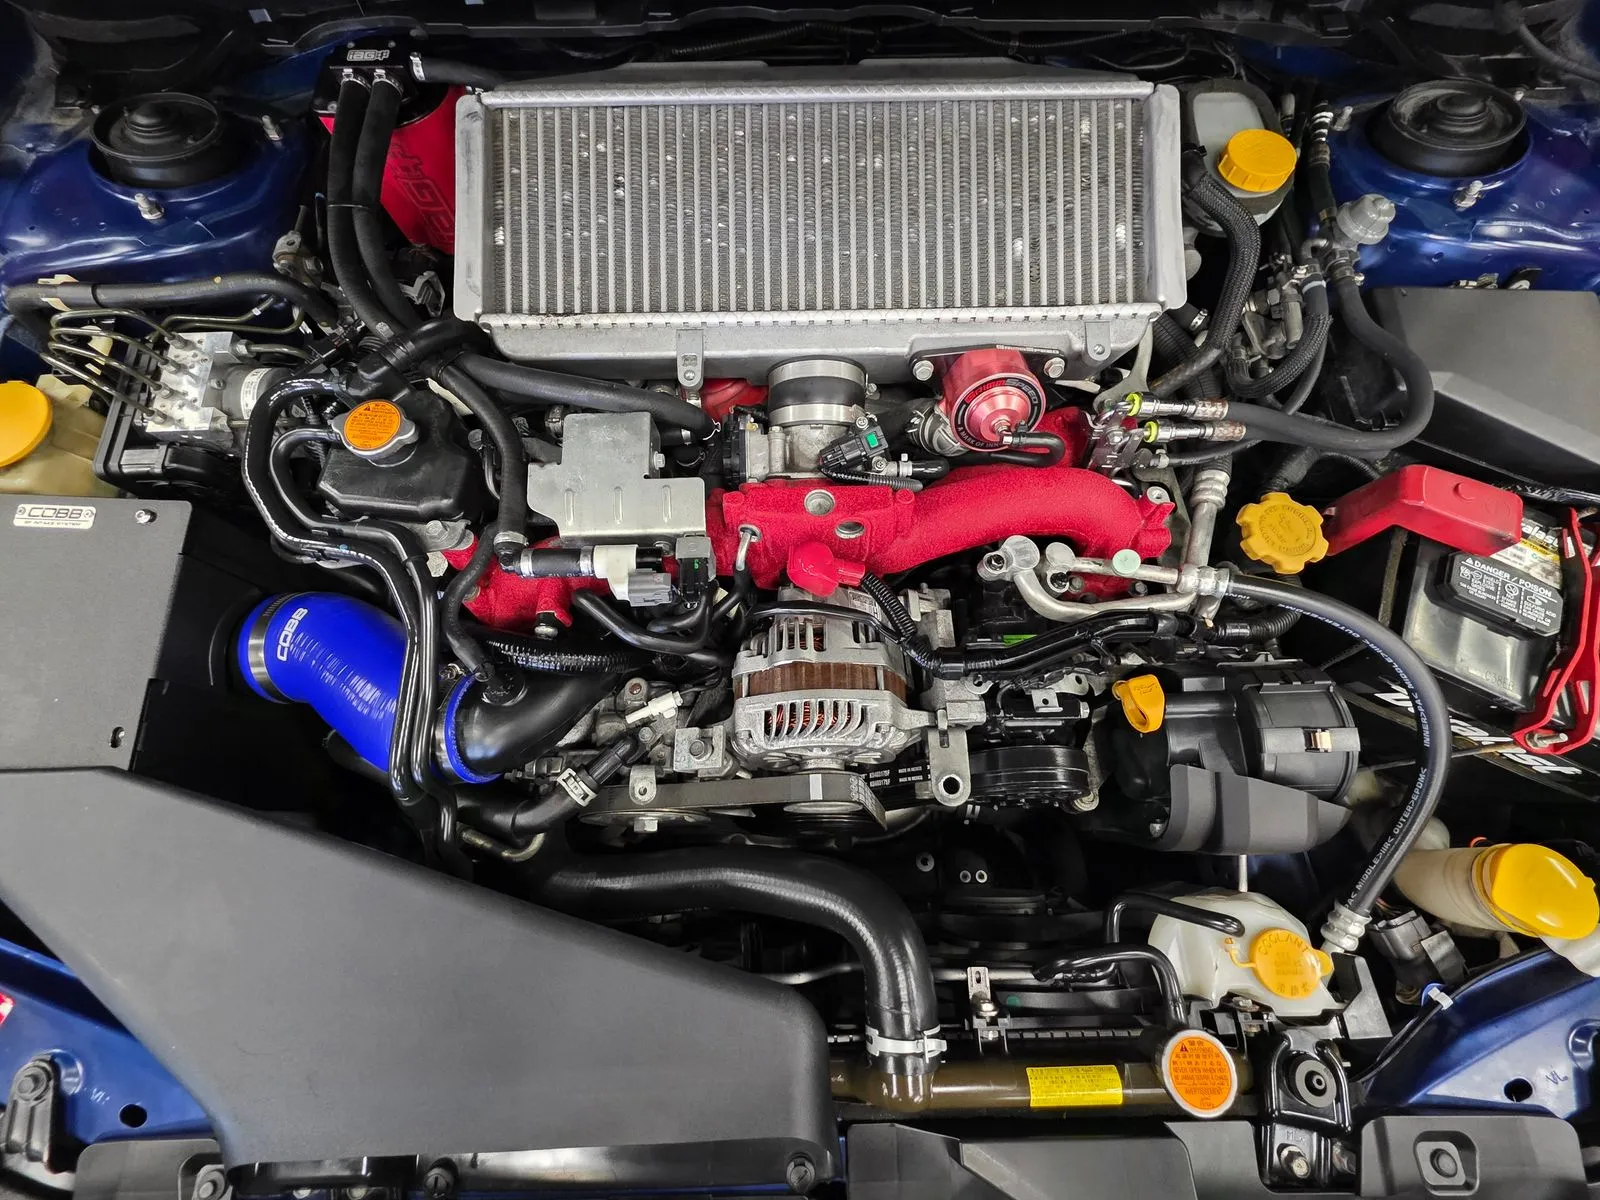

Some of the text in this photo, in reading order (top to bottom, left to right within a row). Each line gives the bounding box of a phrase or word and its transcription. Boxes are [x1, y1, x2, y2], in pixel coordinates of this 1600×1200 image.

[960, 431, 975, 447] MARK
[28, 507, 84, 519] COBB
[1474, 560, 1511, 580] DANGER
[1518, 578, 1552, 598] POISON
[276, 607, 309, 662] COBB
